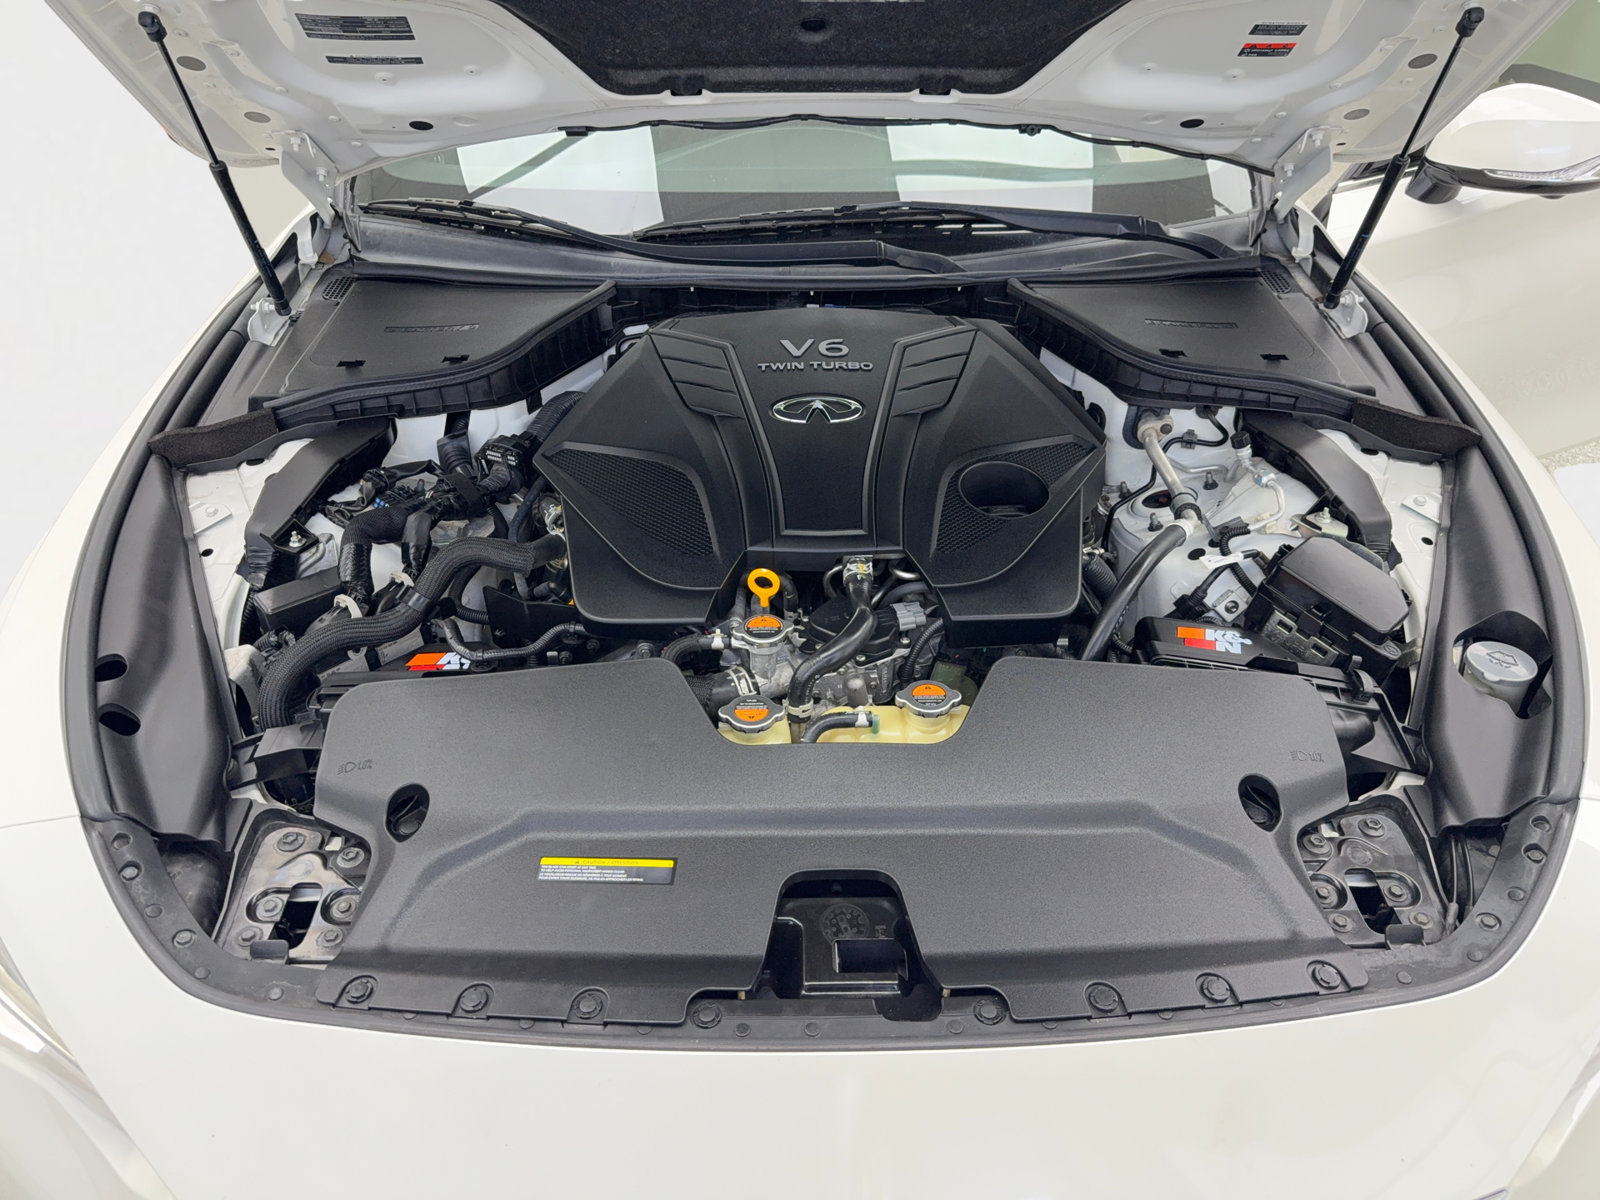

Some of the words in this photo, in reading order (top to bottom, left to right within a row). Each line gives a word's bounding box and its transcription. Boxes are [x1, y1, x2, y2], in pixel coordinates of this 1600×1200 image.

[780, 338, 849, 357] V6
[758, 362, 804, 371] TWIN
[809, 361, 873, 370] TURBO
